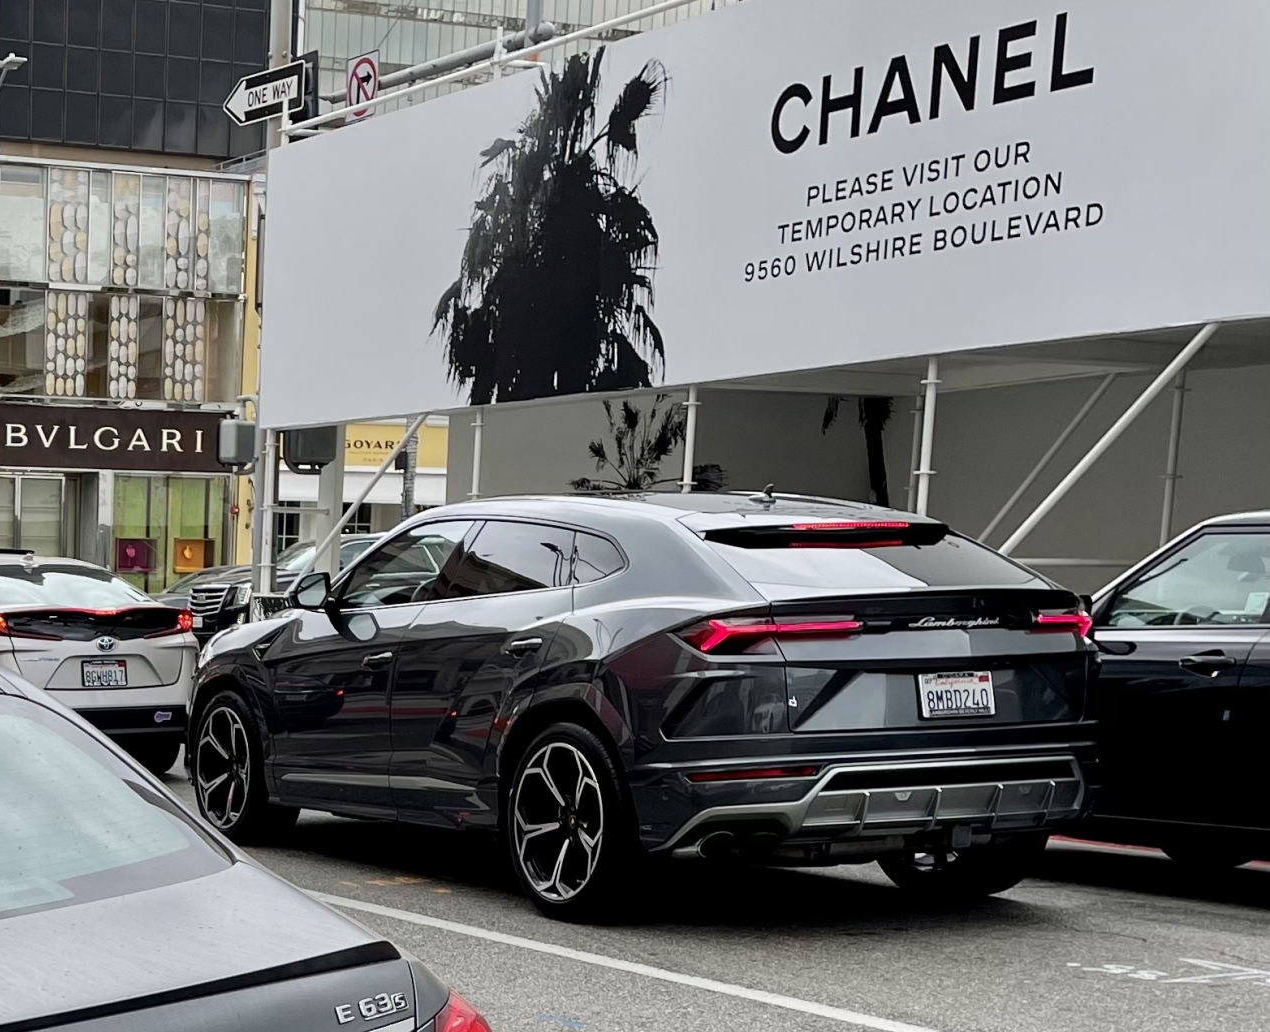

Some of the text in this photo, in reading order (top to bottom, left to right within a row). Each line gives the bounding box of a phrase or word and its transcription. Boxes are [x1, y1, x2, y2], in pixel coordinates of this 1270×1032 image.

[247, 80, 293, 107] ONE WAY
[771, 12, 1094, 154] CHANEL
[807, 141, 1031, 206] PLEASE VISIT OUR
[777, 171, 1062, 244] TEMPORARY LOCATION
[744, 202, 1104, 282] 9560 WILSHIRE BOULEVARD
[4, 423, 204, 453] BVLGARI
[908, 617, 1000, 628] Lamborghini
[927, 688, 989, 710] 8MBD240
[336, 1004, 355, 1024] E
